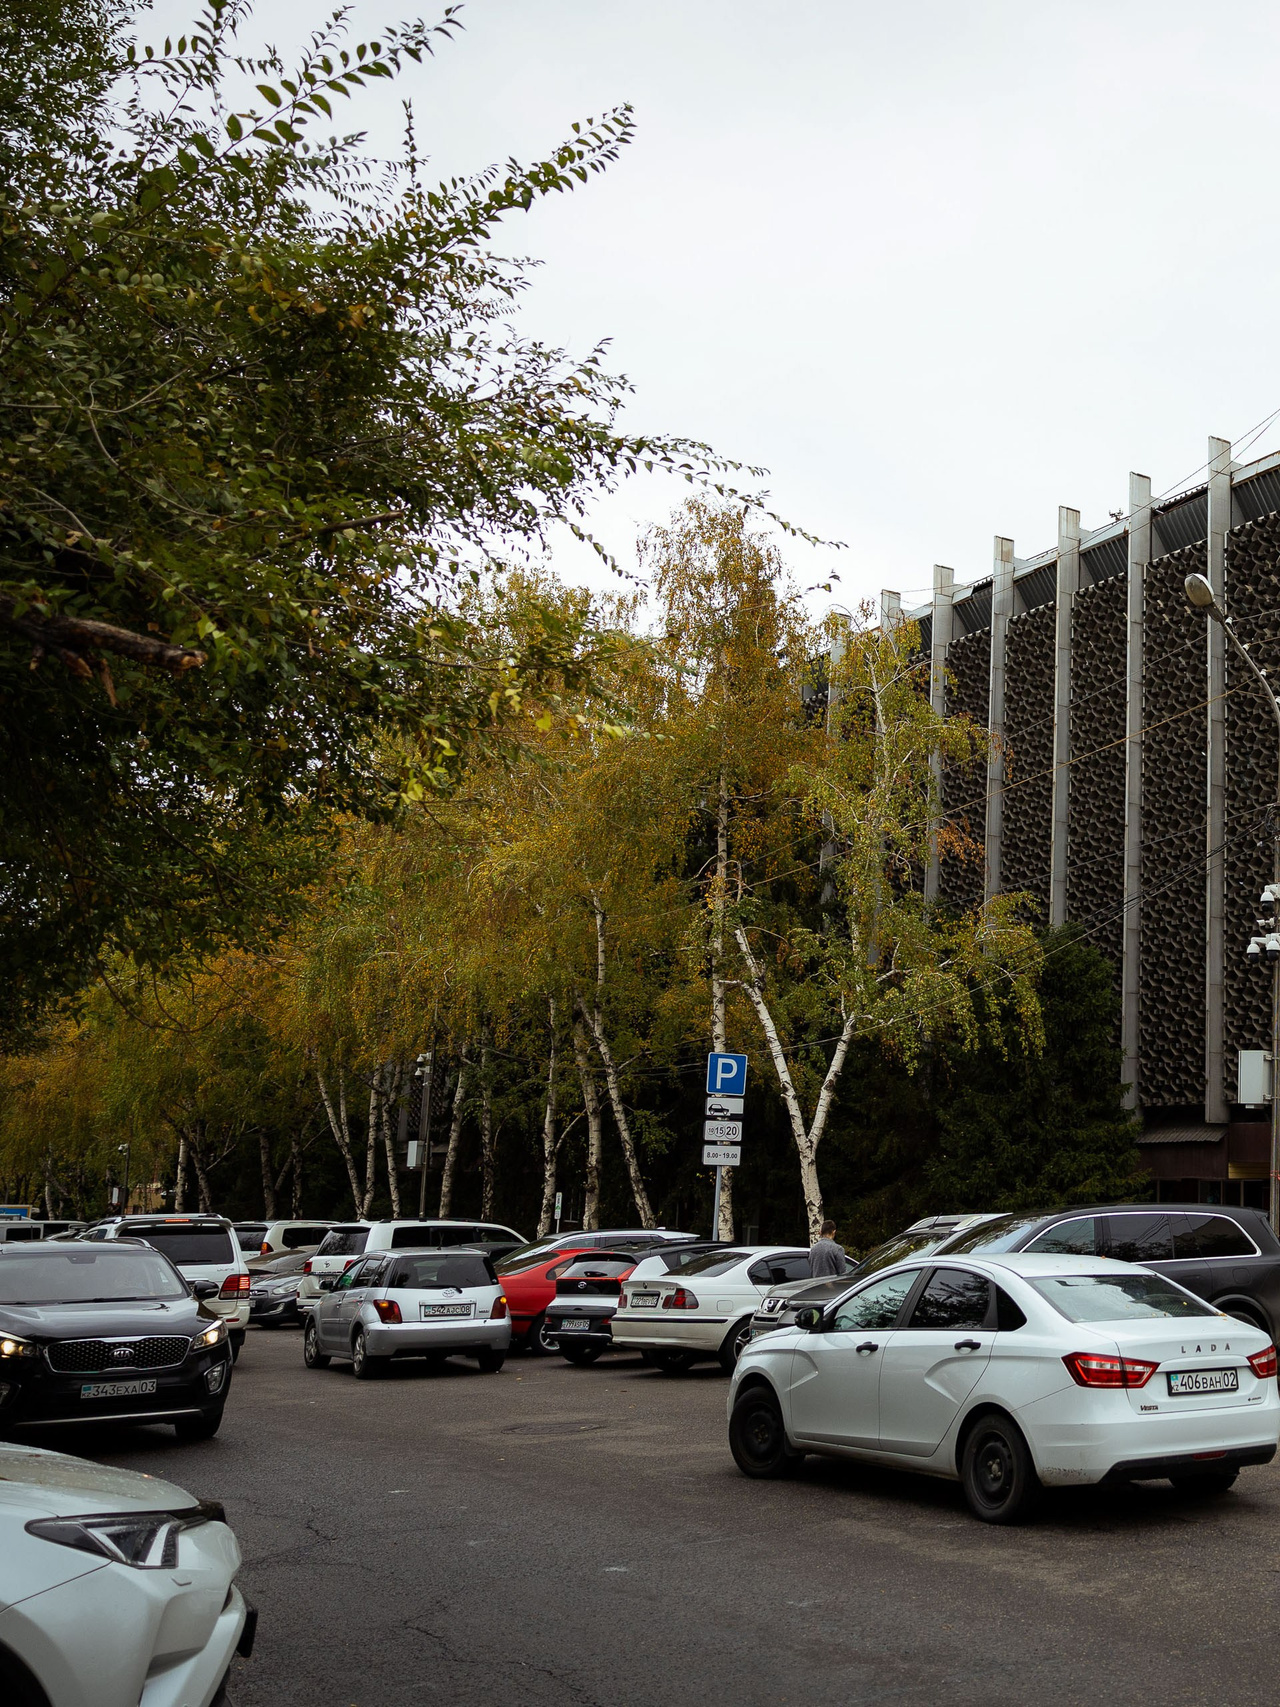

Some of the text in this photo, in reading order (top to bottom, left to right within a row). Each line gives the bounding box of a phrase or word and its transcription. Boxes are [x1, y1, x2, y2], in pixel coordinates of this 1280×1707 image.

[716, 1058, 738, 1089] P
[726, 1126, 737, 1136] 20
[1181, 1343, 1230, 1353] LADA
[113, 1350, 130, 1358] KIA
